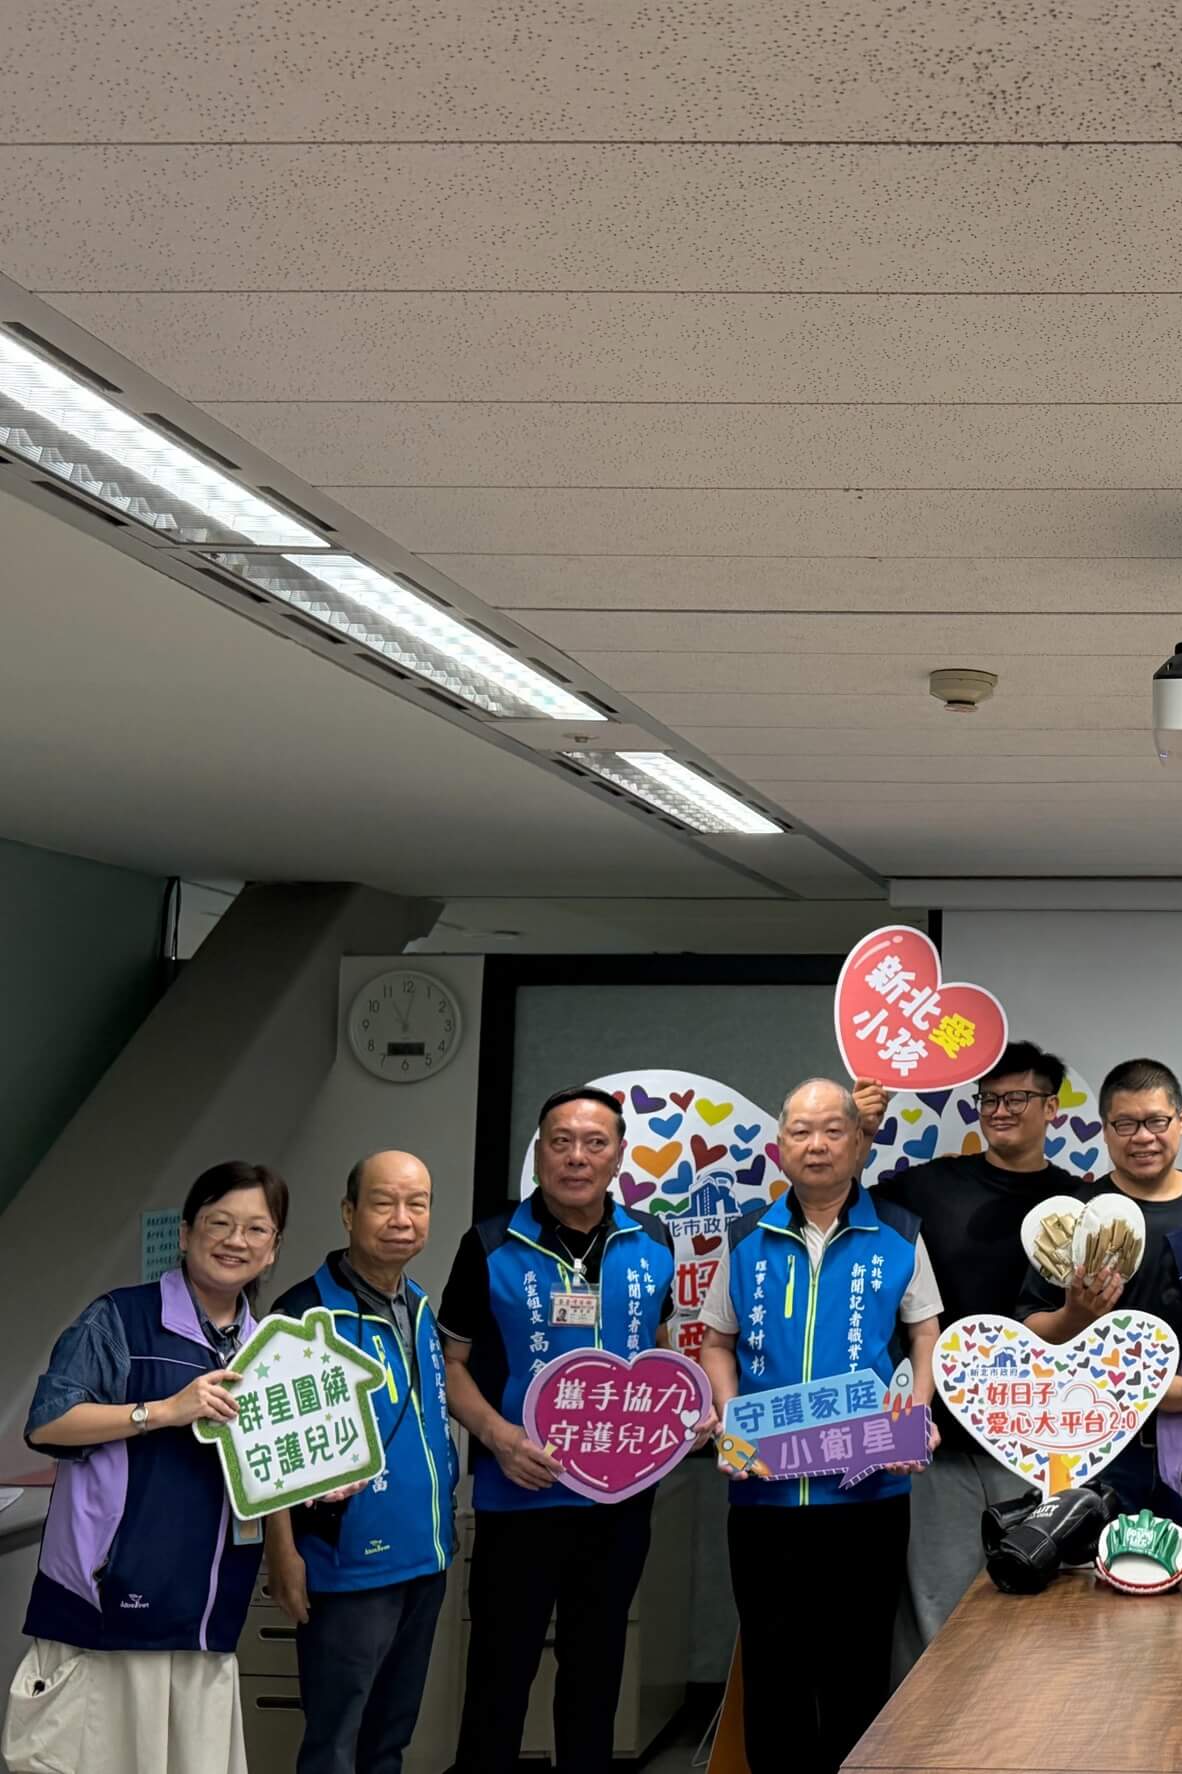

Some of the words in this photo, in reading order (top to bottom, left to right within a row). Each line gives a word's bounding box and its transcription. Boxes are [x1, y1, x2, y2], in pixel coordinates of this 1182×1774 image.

[852, 1008, 929, 1077] 小孩
[871, 1254, 884, 1292] 新北市
[969, 1368, 1018, 1378] 新北市政府
[986, 1382, 1055, 1406] 好日子
[235, 1365, 351, 1434] 群星圍繞
[554, 1378, 687, 1415] 攜手協力
[733, 1380, 879, 1433] 守護家庭
[245, 1416, 359, 1483] 守護兒少
[548, 1420, 680, 1456] 守護兒少
[780, 1418, 896, 1470] 小衛星
